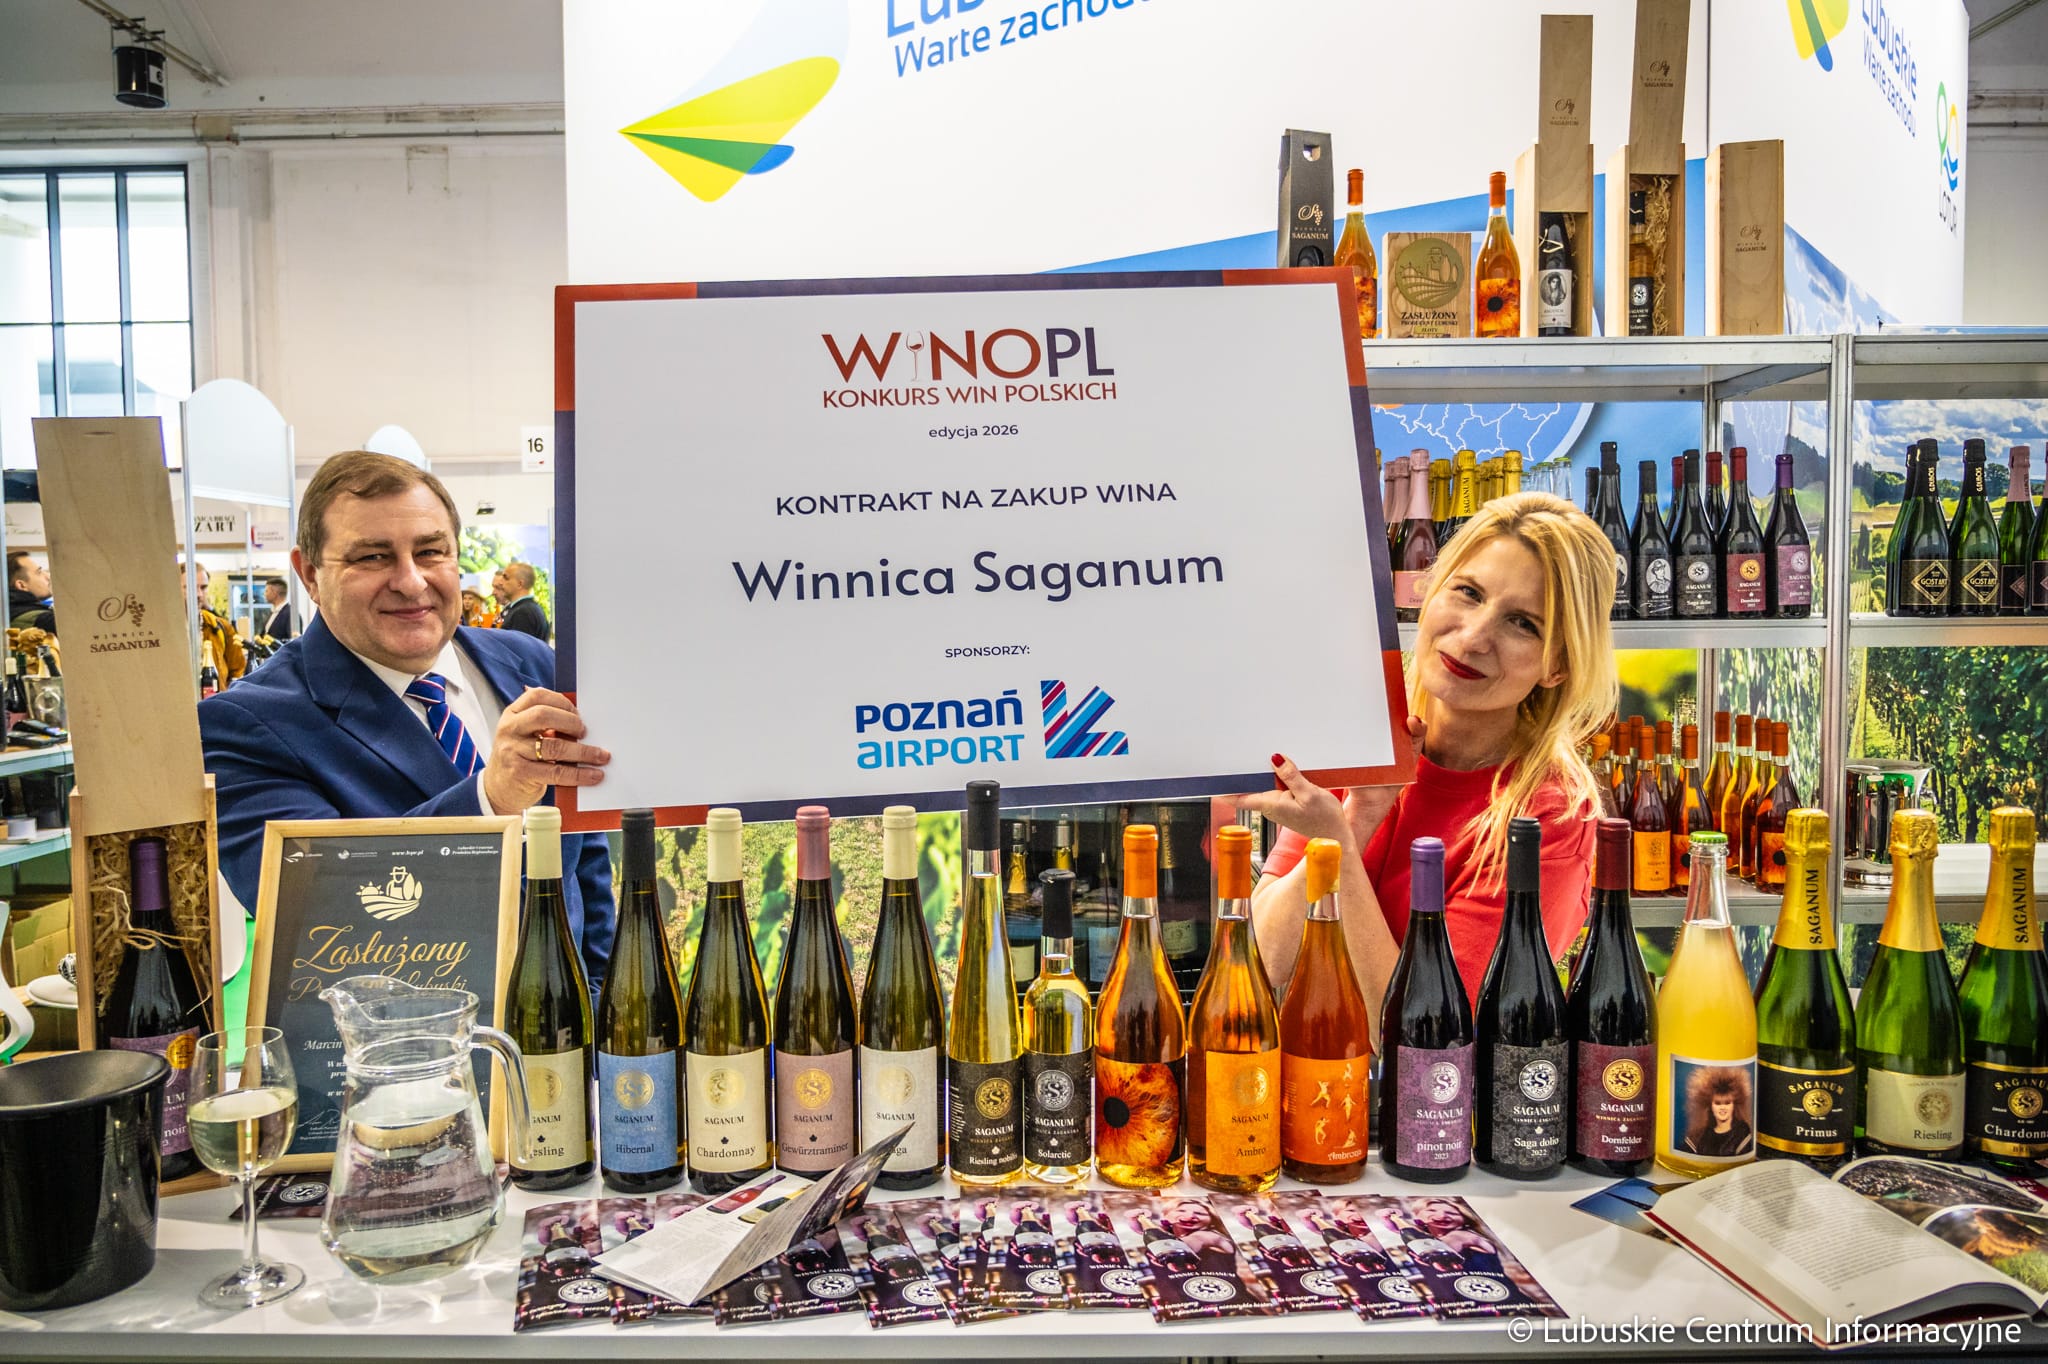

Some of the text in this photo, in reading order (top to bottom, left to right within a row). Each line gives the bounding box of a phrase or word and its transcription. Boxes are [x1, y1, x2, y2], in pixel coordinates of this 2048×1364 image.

[894, 0, 1149, 77] Warte zacho
[1863, 30, 1916, 138] Warte zachodu
[1401, 310, 1457, 320] ZASŁUŻONY
[823, 382, 1117, 409] KONKURS WIN POLSKICH
[929, 425, 1019, 439] edycja 2026
[527, 437, 544, 453] 16
[776, 483, 1177, 516] KONTRAKT NA ZAKUP WINA
[732, 551, 1223, 603] Winnica Saganum
[93, 631, 154, 640] WINNICA
[90, 638, 161, 654] SAGANUM
[944, 645, 1031, 659] SPONSORZY:
[1806, 869, 1823, 945] SAGANUM
[2015, 867, 2029, 944] SAGANUM
[293, 925, 471, 978] Zasłużony
[304, 1039, 342, 1051] Marcin
[1788, 1080, 1844, 1096] SAGANUM
[1994, 1078, 2048, 1091] SAGANU
[1416, 1108, 1463, 1119] SAGANUM
[1513, 1104, 1560, 1116] SAGANUM
[1600, 1103, 1644, 1113] SAGANUM
[614, 1115, 654, 1124] SAGANUM
[704, 1116, 744, 1125] SAGANUM
[794, 1114, 833, 1122] SAGANUM
[876, 1112, 915, 1121] SAGANUM
[1035, 1117, 1074, 1127] SAGANUM
[1232, 1113, 1269, 1123] SAGANUM
[975, 1124, 1014, 1136] SAGANUM
[1795, 1125, 1838, 1137] Primus
[1913, 1129, 1953, 1141] Riesling
[1984, 1123, 2048, 1139] Chardonn
[1417, 1139, 1462, 1152] pinot noir
[1514, 1136, 1560, 1149] Saga dolio
[1601, 1134, 1642, 1145] Dornfelder
[530, 1146, 565, 1157] esling
[615, 1144, 655, 1154] Hibernal
[696, 1146, 756, 1158] Chardonnay
[781, 1141, 849, 1155] Gewürztraminer
[1038, 1148, 1072, 1159] Solarctic
[1236, 1147, 1266, 1157] Ambro
[969, 1156, 997, 1166] Riesling
